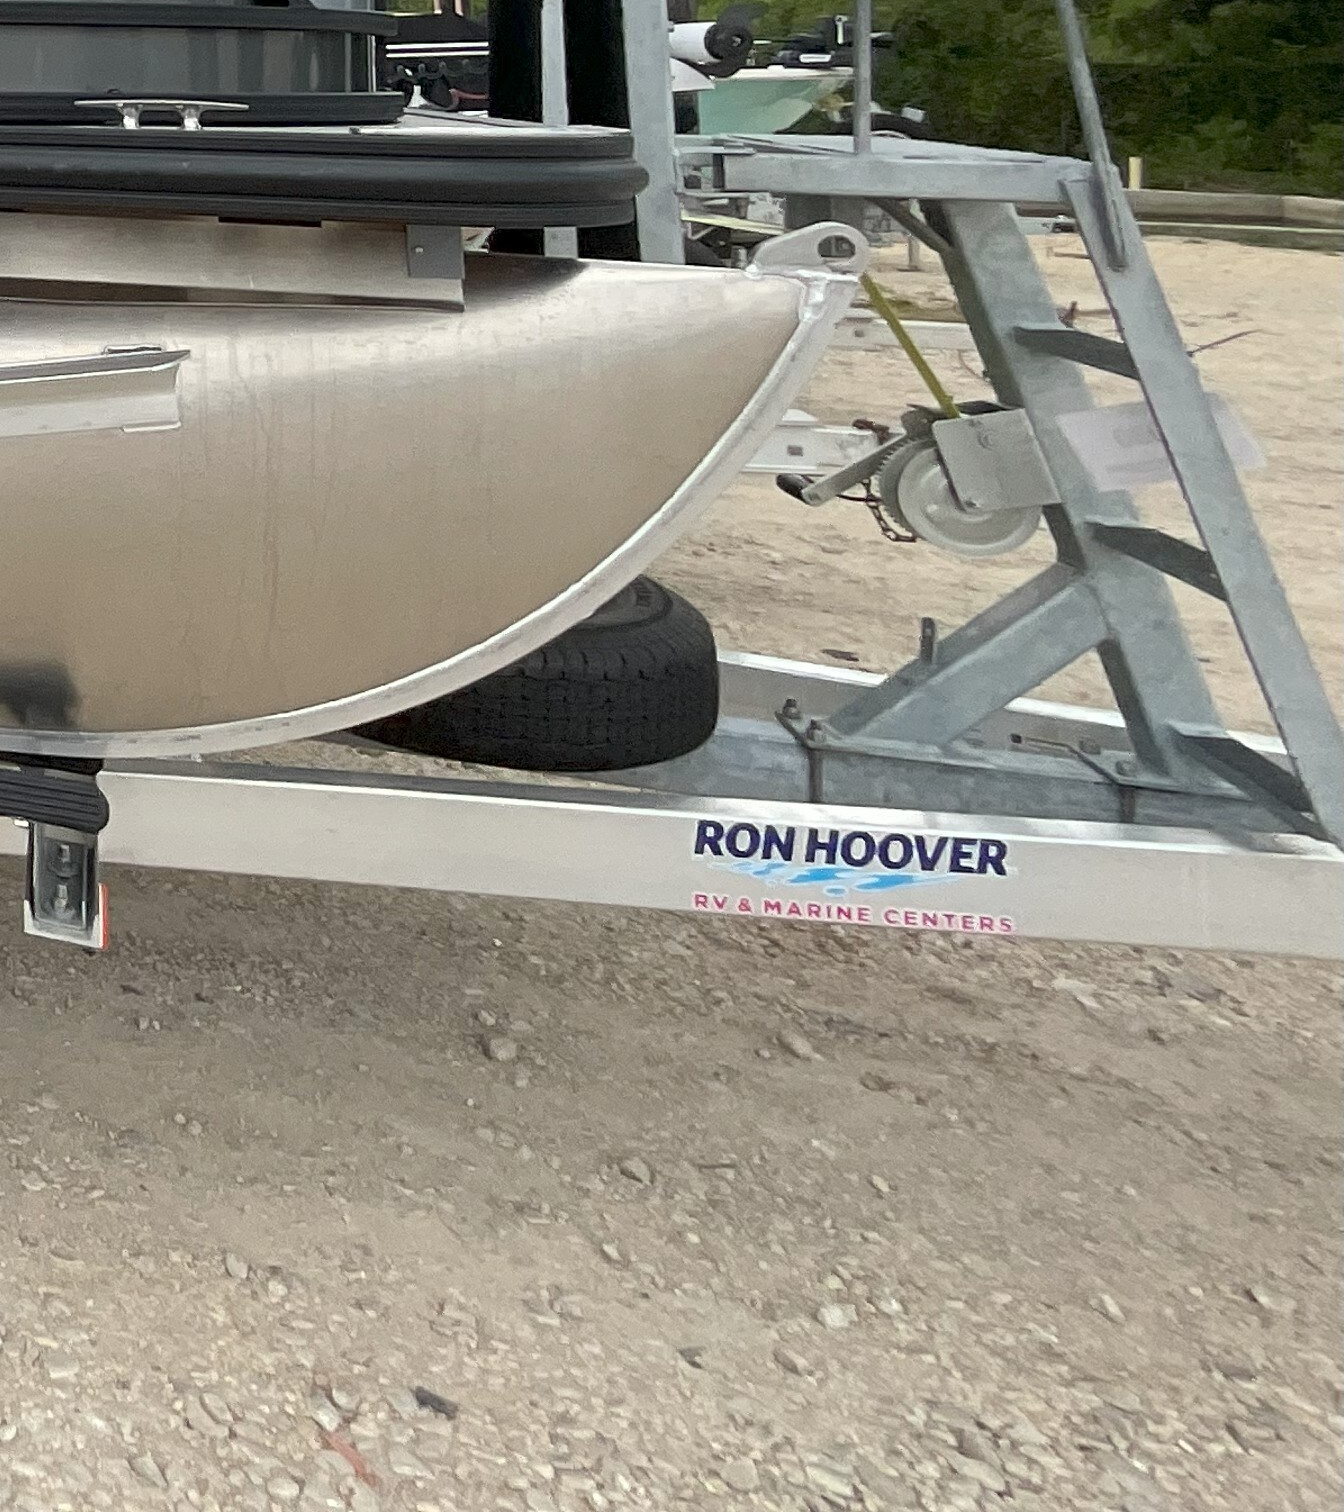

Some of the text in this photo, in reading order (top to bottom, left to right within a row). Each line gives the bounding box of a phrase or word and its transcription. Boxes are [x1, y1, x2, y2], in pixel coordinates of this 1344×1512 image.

[693, 819, 1009, 877] RON HOOVER
[693, 893, 1013, 934] RV & MARINE CENTERS
